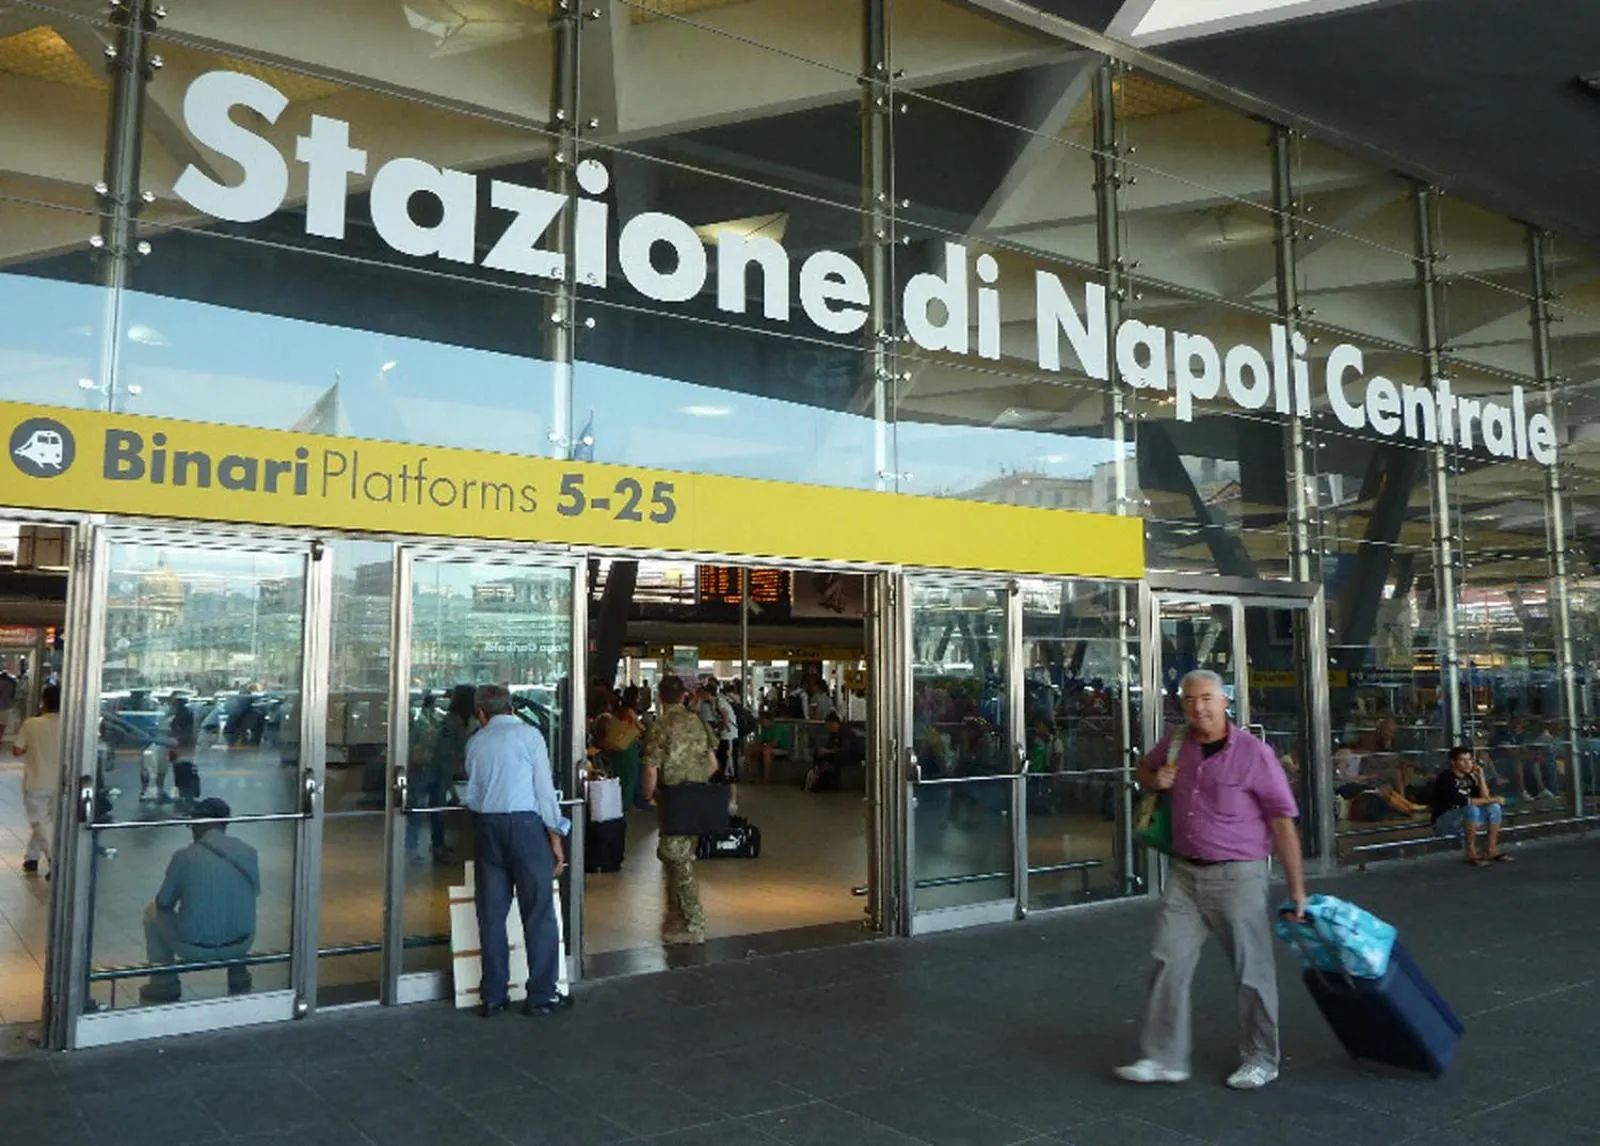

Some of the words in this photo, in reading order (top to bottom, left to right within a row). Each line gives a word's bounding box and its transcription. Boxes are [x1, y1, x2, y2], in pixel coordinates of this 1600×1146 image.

[174, 71, 870, 334] Stazione
[902, 242, 1000, 360] di
[1036, 270, 1310, 421] Napoli
[1326, 343, 1556, 464] Centrale
[103, 429, 309, 496] Binari
[321, 449, 537, 513] Platforms
[556, 474, 677, 524] 5-25
